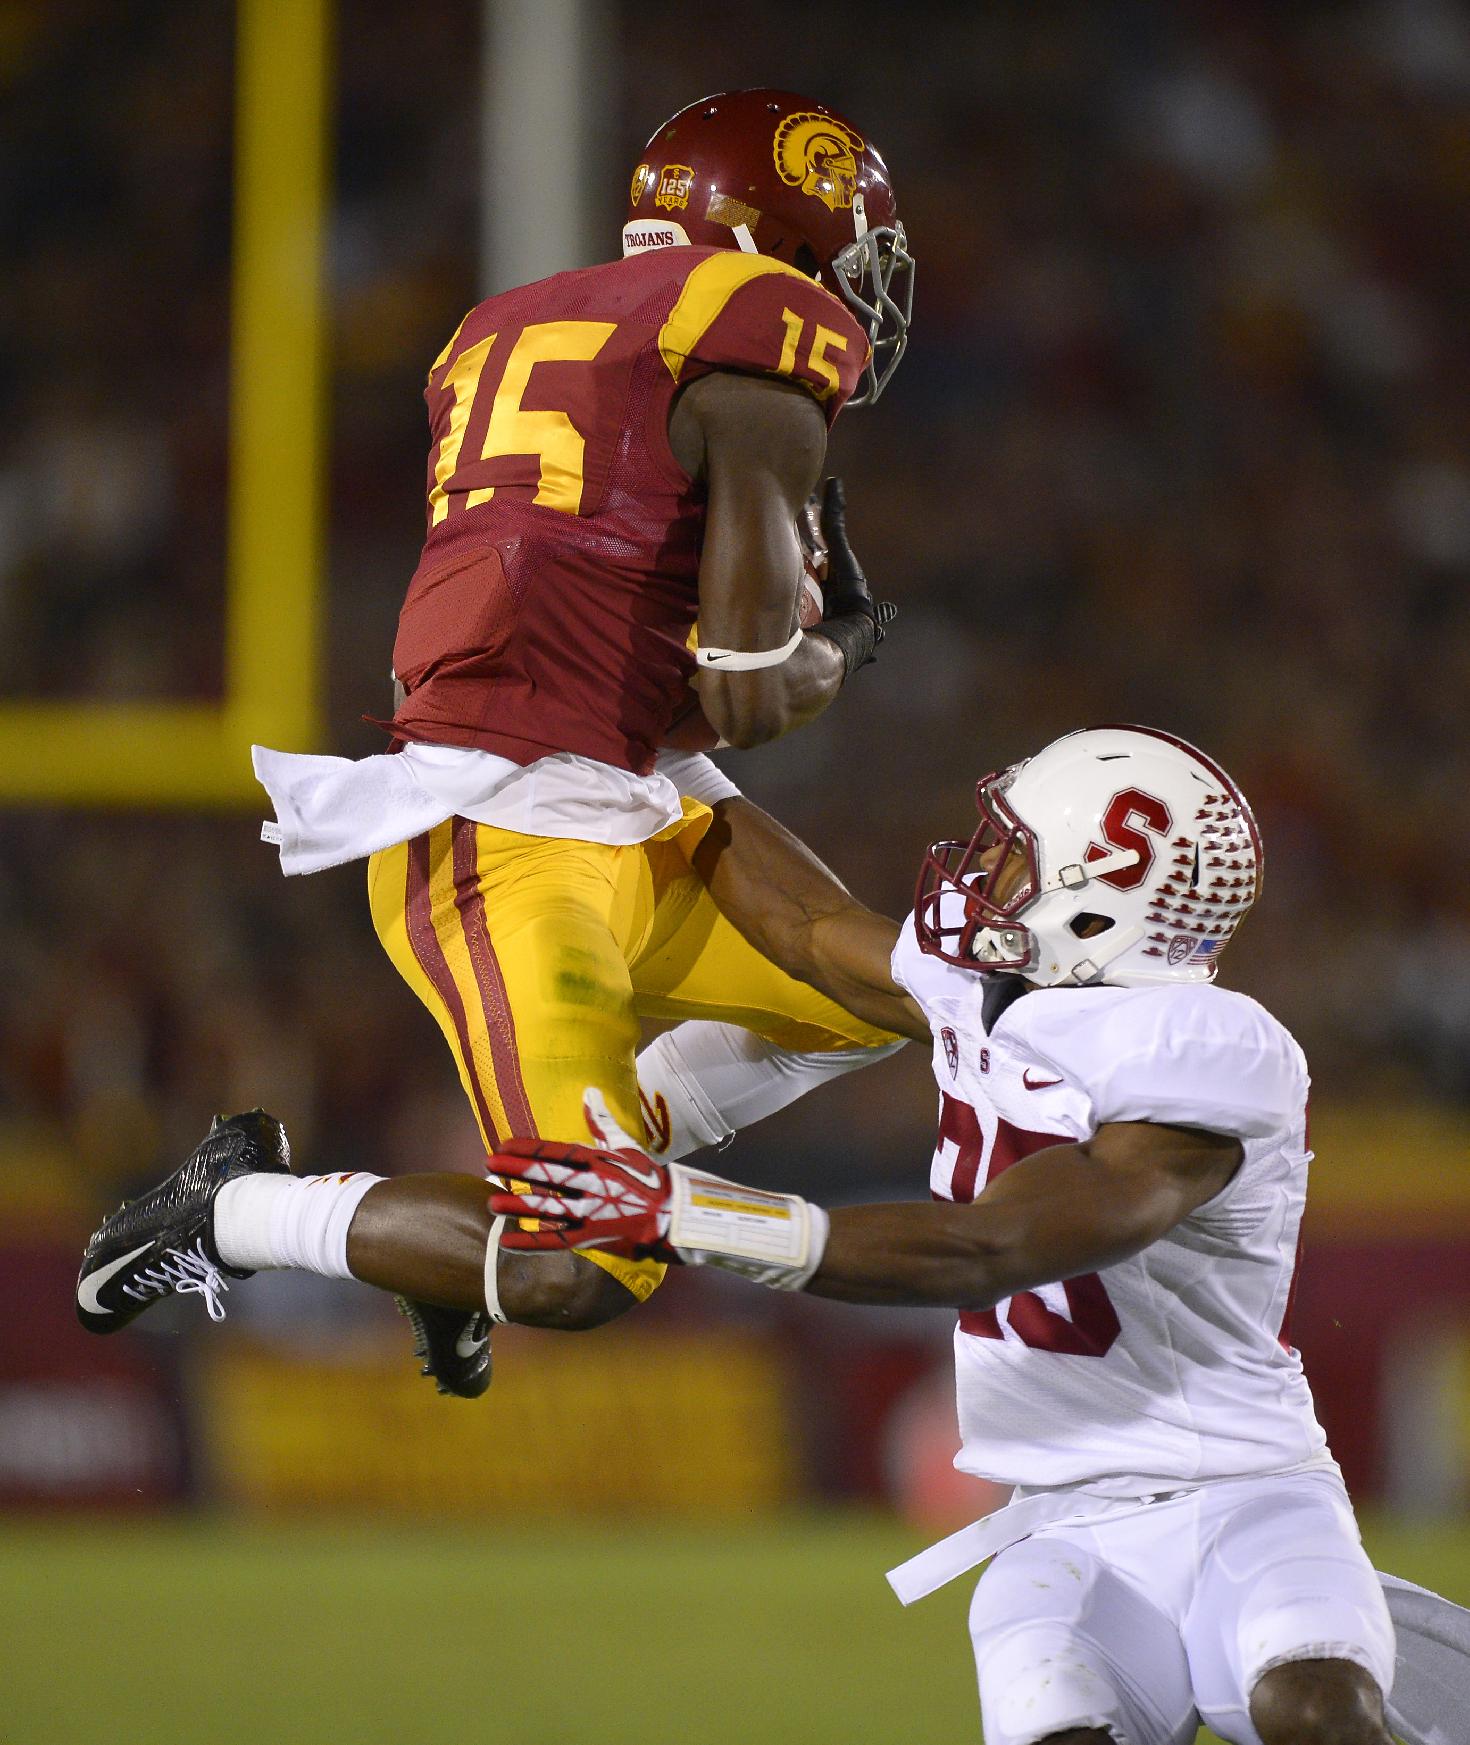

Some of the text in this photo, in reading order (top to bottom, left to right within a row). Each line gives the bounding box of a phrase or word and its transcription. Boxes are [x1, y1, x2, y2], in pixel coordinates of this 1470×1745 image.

[660, 178, 688, 197] 125
[625, 231, 674, 247] TROJANS
[766, 306, 849, 401] 15
[429, 320, 618, 527] 15
[1083, 786, 1174, 892] S
